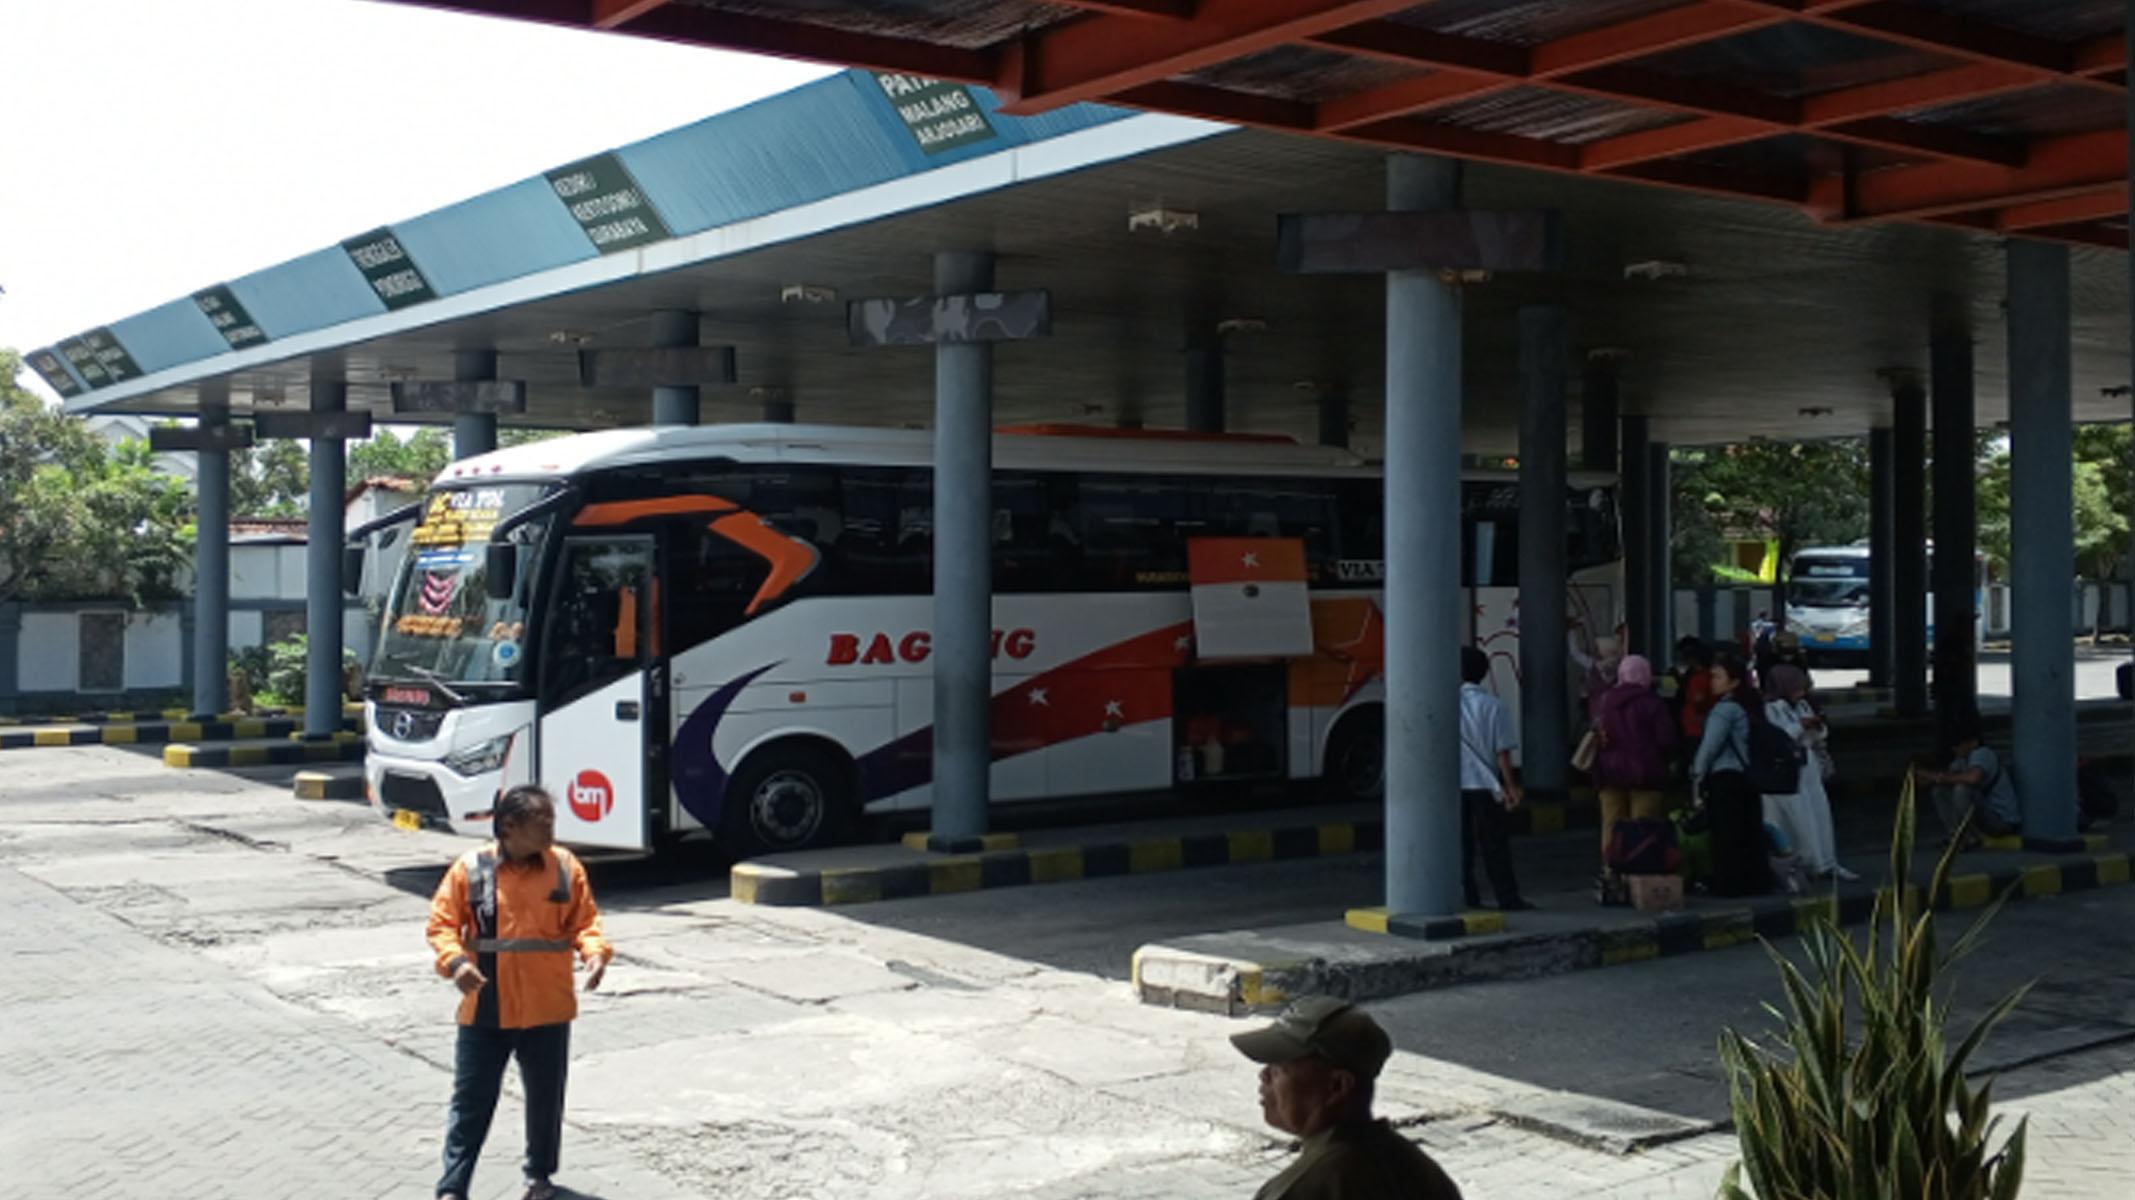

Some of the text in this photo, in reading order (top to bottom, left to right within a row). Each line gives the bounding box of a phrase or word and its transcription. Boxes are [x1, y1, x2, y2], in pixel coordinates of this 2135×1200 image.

[879, 74, 940, 98] PAT
[898, 90, 970, 123] MALANG
[1340, 562, 1375, 578] VIA
[826, 629, 1036, 666] BAGG
